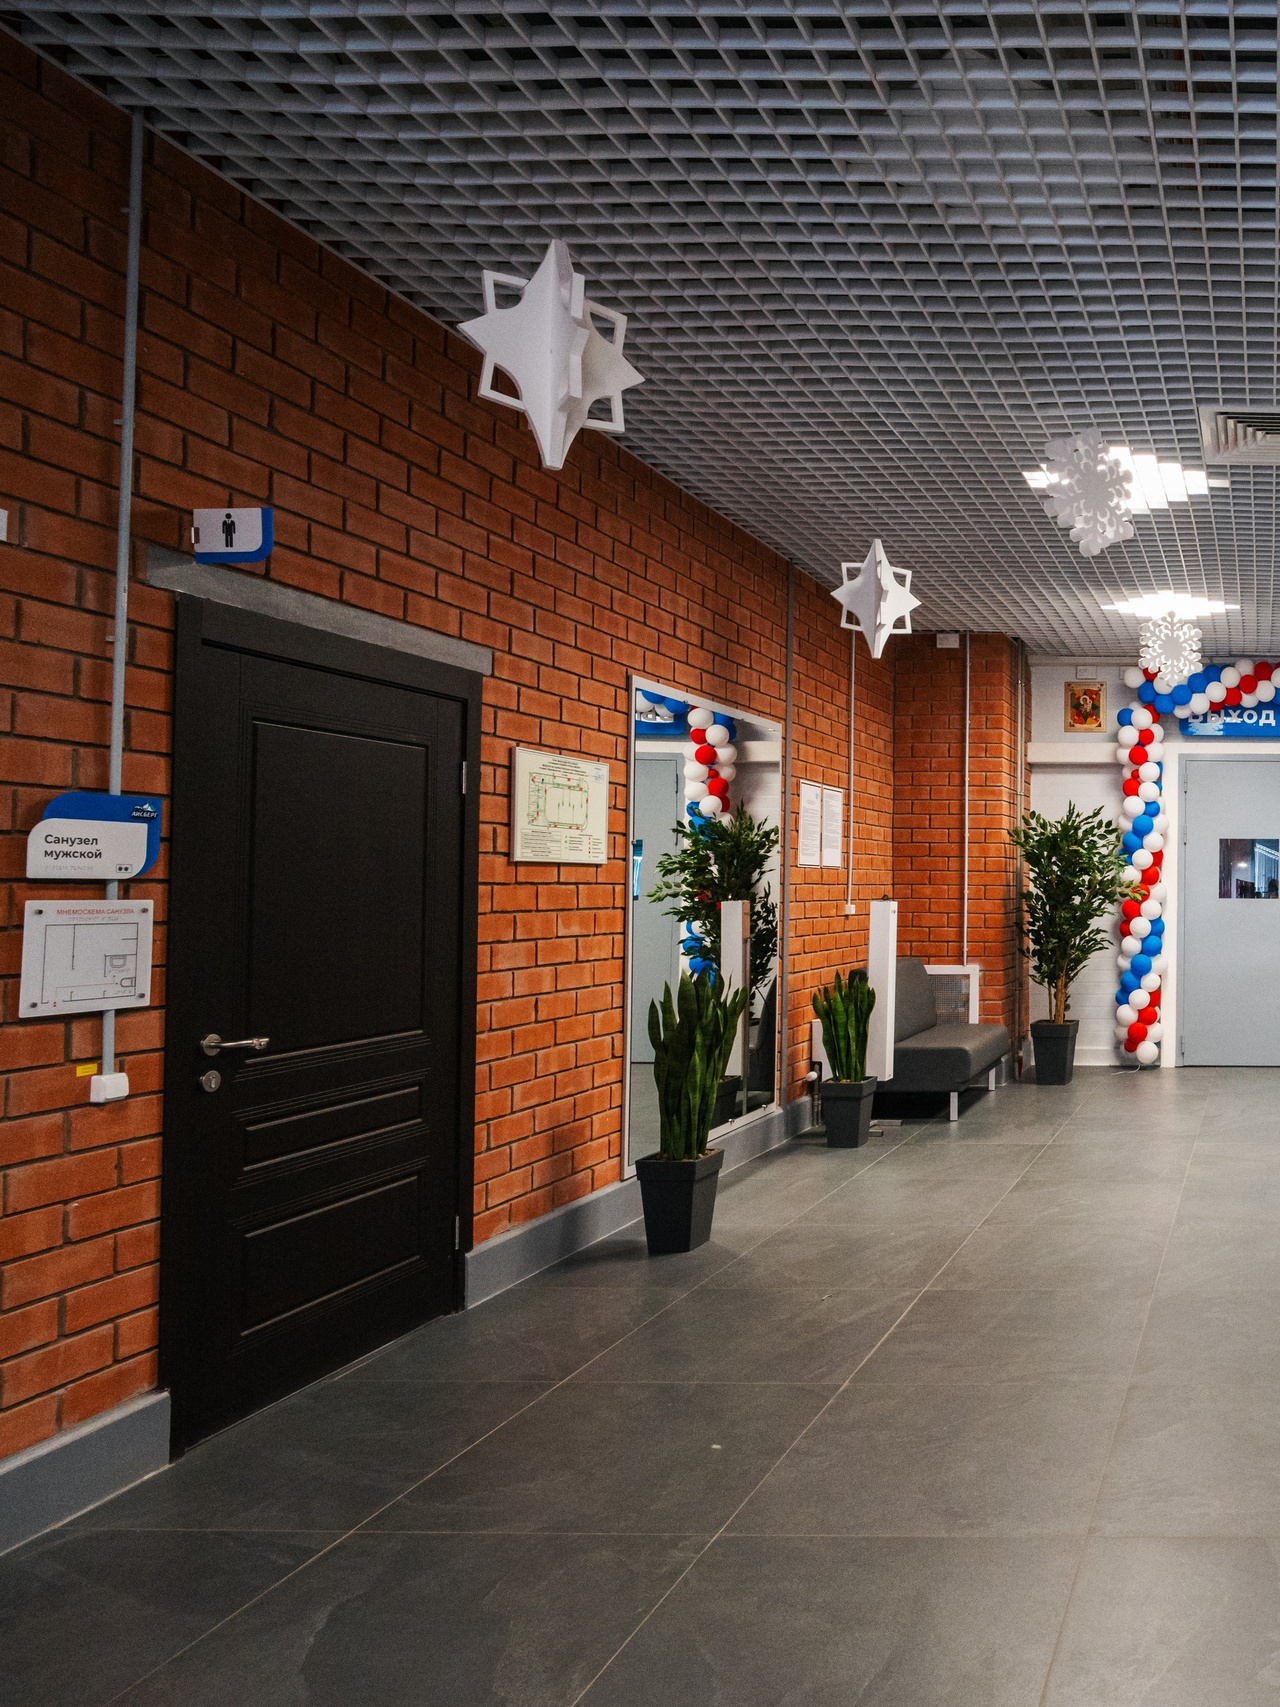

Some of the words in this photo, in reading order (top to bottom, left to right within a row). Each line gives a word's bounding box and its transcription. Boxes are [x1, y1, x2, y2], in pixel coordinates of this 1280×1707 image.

[44, 834, 98, 846] Санузел
[44, 849, 102, 860] мужской
[56, 908, 106, 916] МНЕМОСХЕМА
